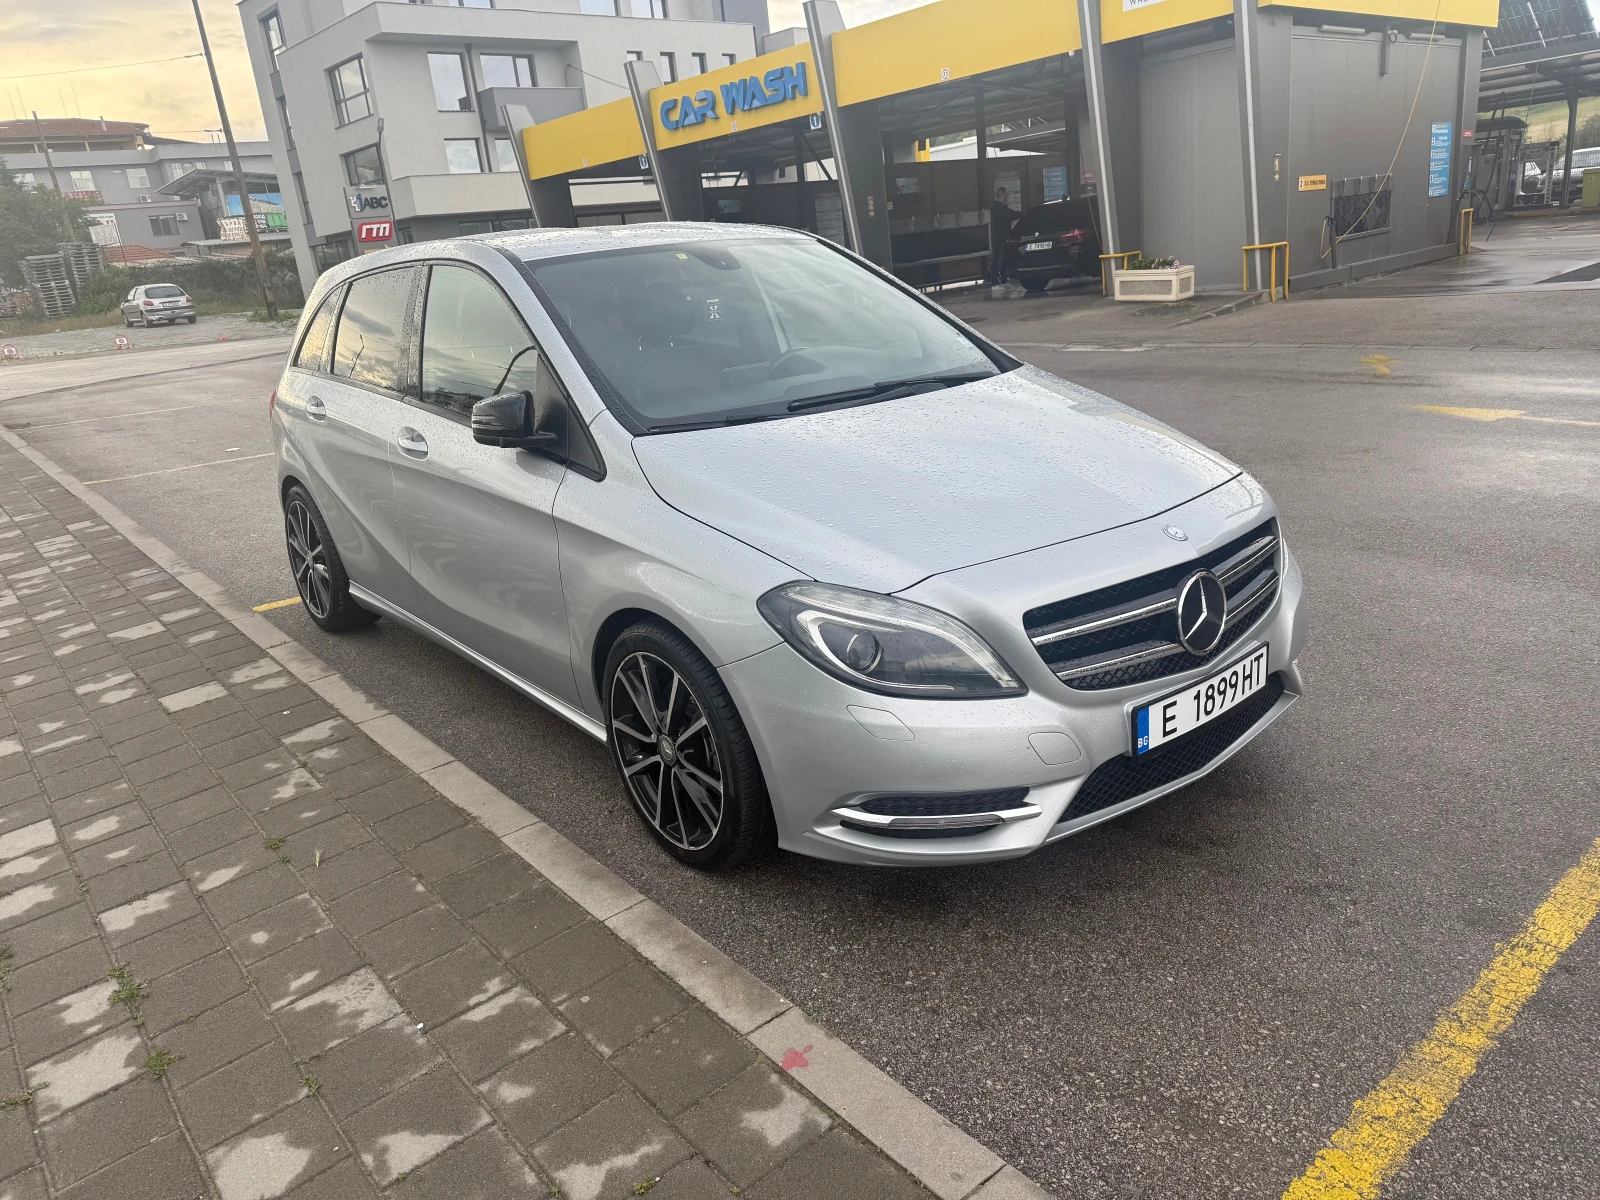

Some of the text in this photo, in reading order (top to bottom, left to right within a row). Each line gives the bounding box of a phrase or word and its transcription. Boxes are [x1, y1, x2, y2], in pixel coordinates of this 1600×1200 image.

[660, 62, 808, 131] CAR WASH
[361, 223, 390, 239] ГТП
[1162, 652, 1264, 738] E 1899HT
[1137, 735, 1148, 749] BG
